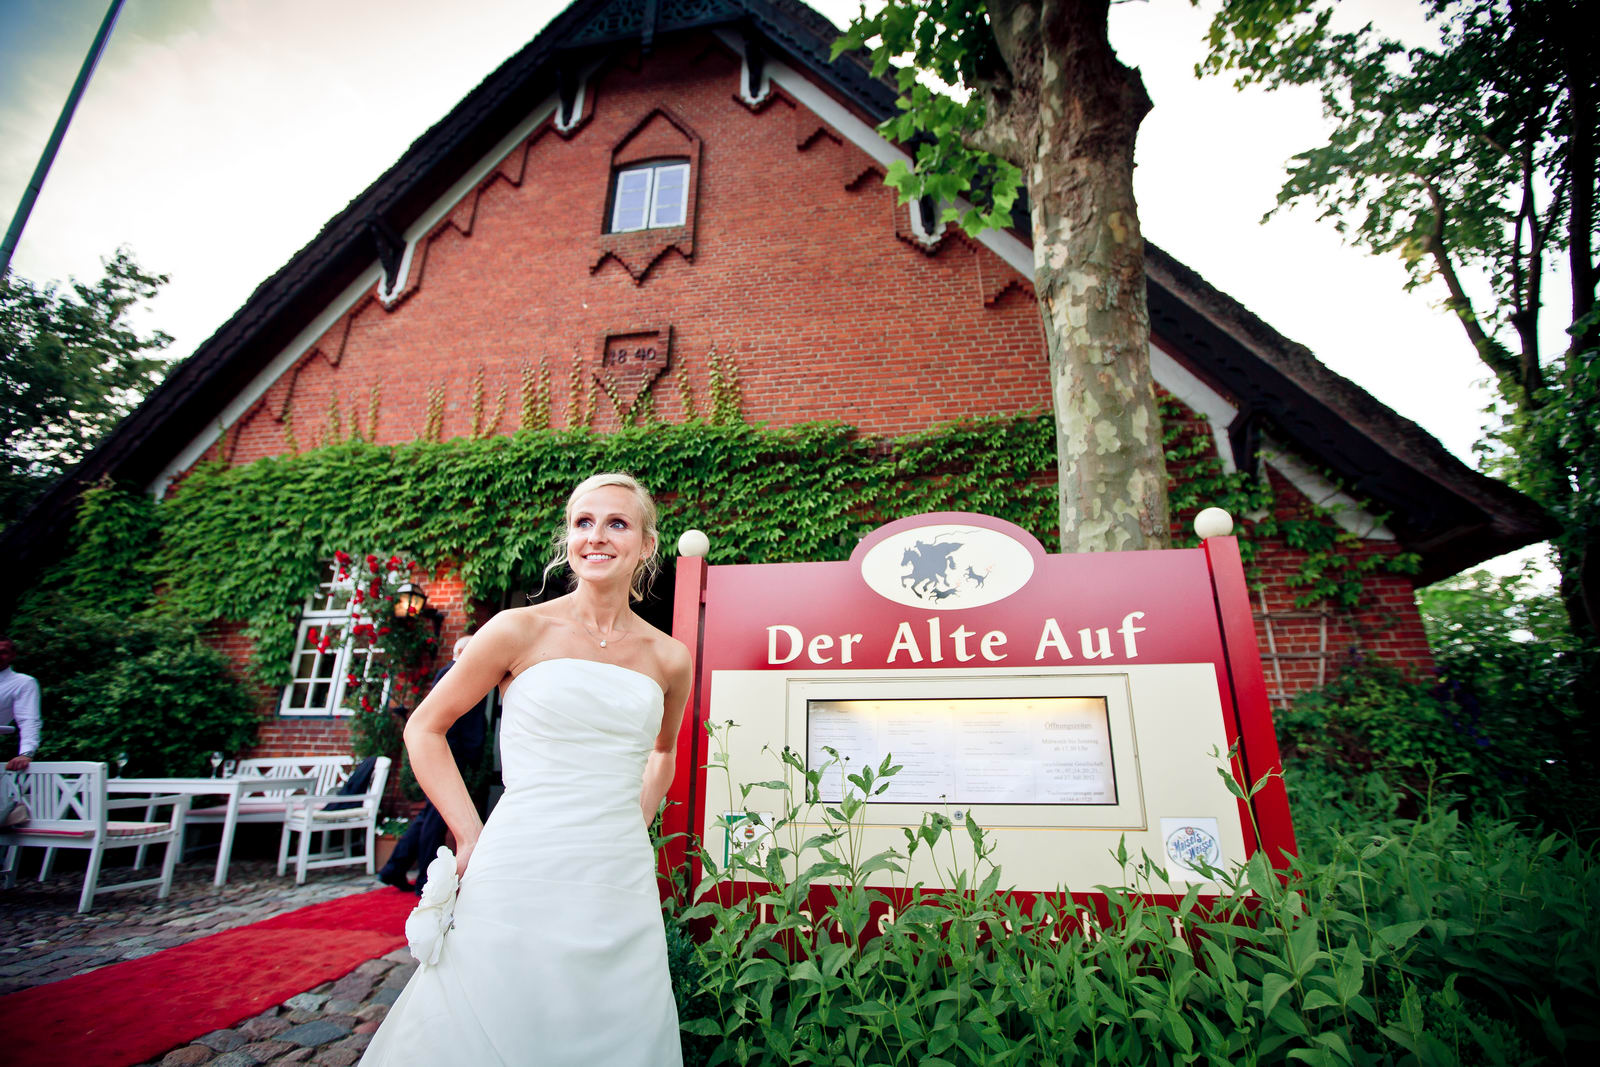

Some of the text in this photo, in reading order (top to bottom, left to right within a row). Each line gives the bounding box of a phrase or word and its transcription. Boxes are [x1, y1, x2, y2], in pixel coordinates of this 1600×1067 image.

[766, 611, 1146, 665] Der Alte Auf
